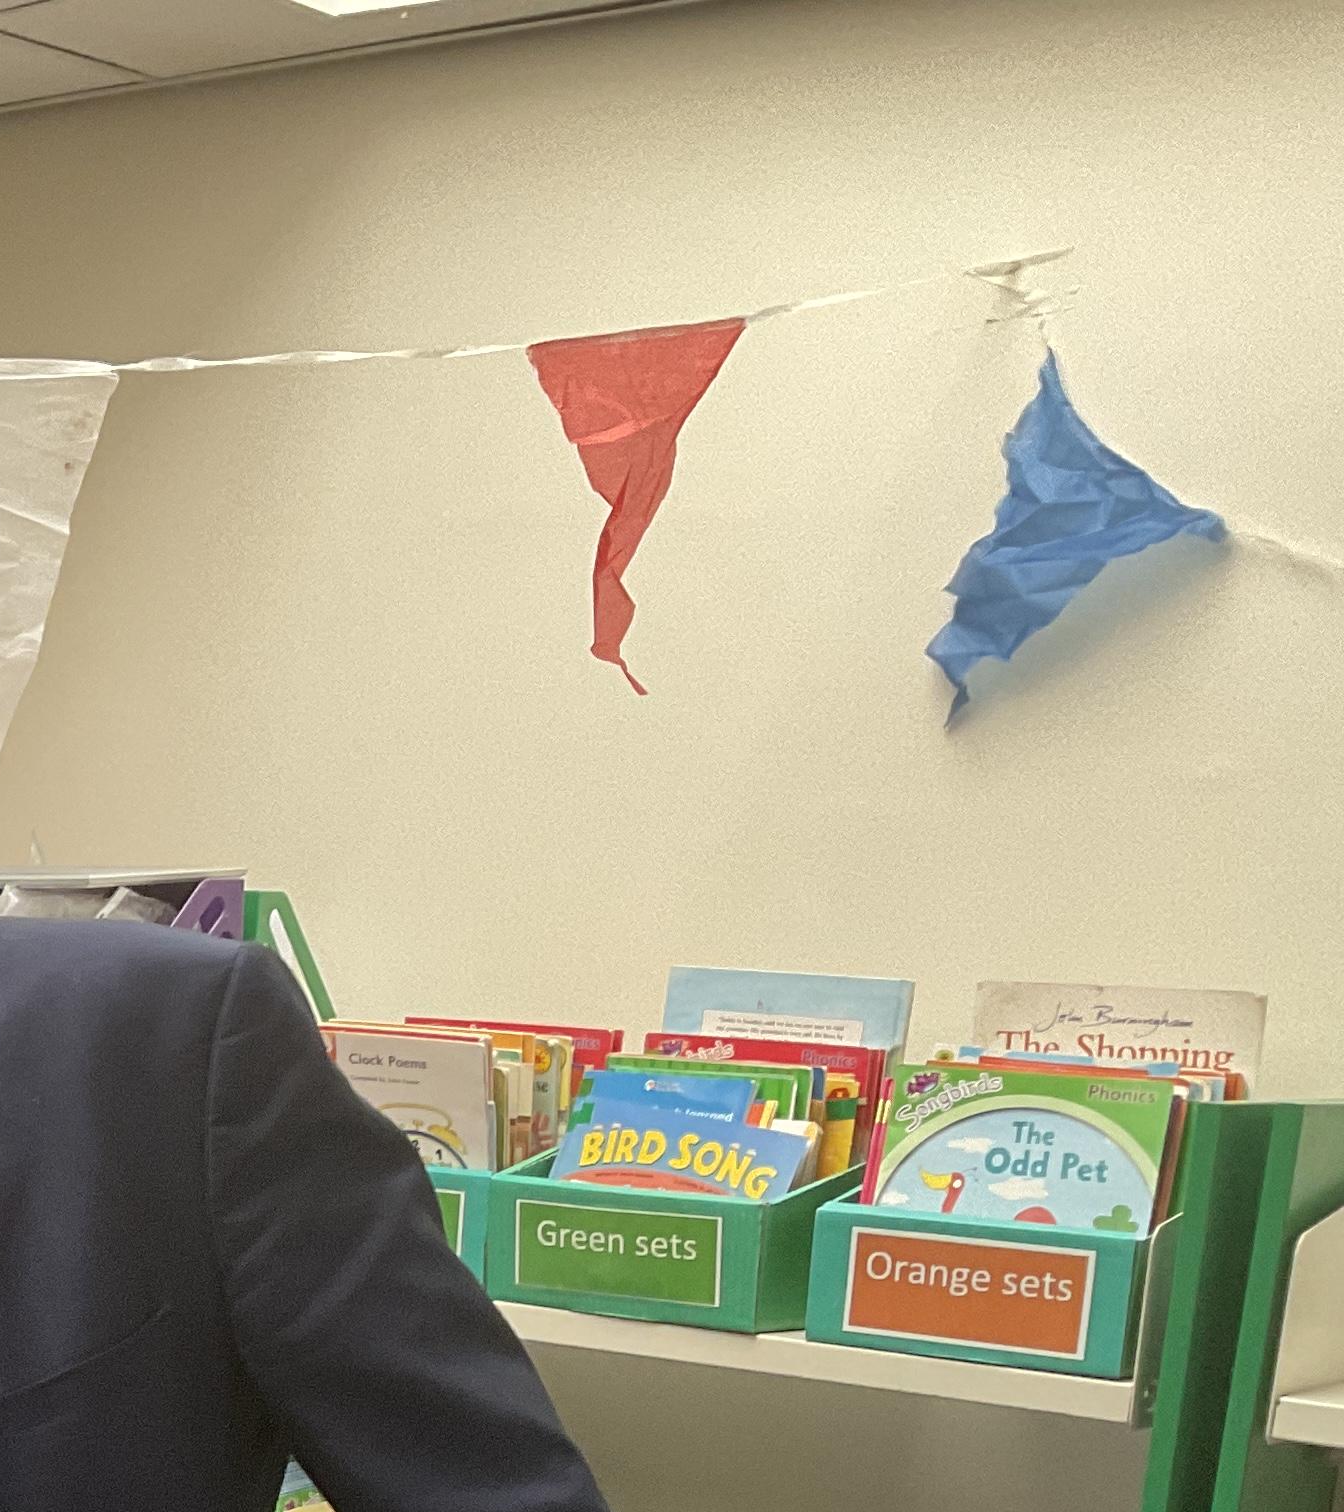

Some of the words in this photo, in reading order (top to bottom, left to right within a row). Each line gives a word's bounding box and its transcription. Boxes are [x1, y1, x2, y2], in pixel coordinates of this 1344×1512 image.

[996, 1030, 1060, 1054] The
[348, 1053, 384, 1066] Clock
[388, 1055, 427, 1069] Poems
[801, 1048, 858, 1069] Phonics
[895, 1072, 1004, 1133] Songbirds
[1087, 1084, 1156, 1104] Phonics
[1012, 1121, 1056, 1146] The
[578, 1127, 668, 1167] BIRD
[668, 1132, 778, 1200] SONG
[984, 1147, 1051, 1178] Odd
[1060, 1152, 1109, 1183] Pet
[536, 1220, 625, 1255] Green
[635, 1226, 698, 1261] sets
[866, 1251, 991, 1297] Orange
[1001, 1259, 1074, 1303] sets
